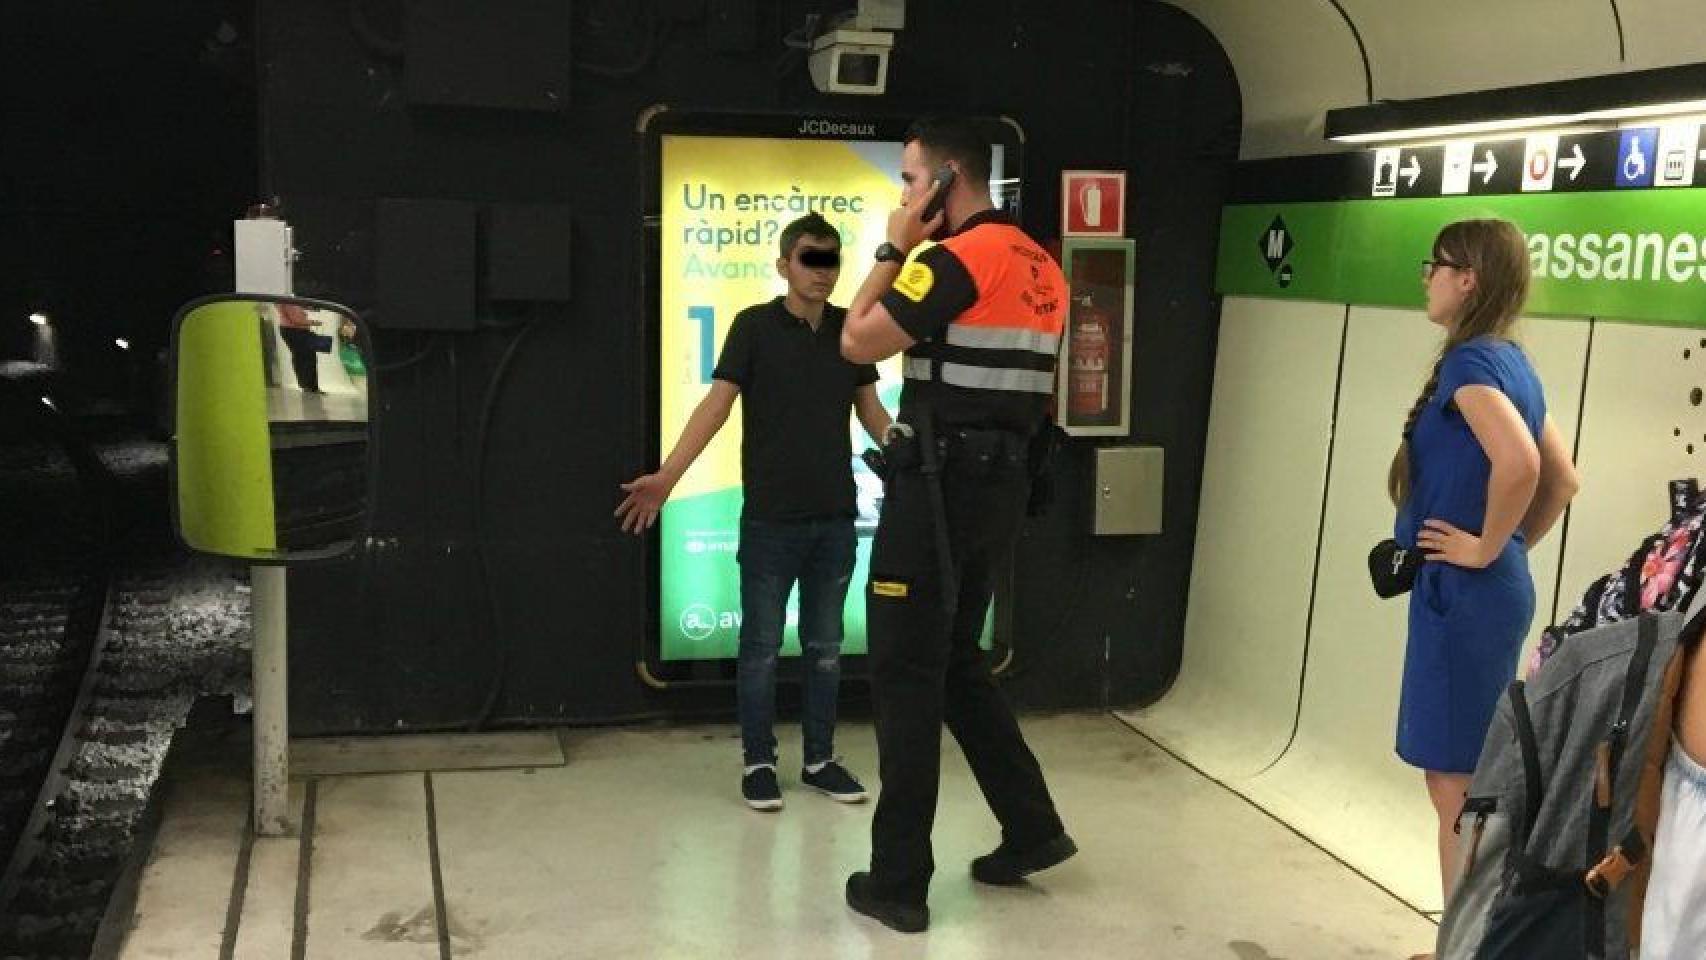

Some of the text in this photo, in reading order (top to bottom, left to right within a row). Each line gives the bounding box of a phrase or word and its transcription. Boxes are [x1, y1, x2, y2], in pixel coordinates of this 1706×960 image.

[798, 119, 876, 136] JCDecaux
[683, 183, 865, 213] Un encàrrec
[683, 218, 779, 253] ràpid?
[1525, 231, 1706, 282] assane
